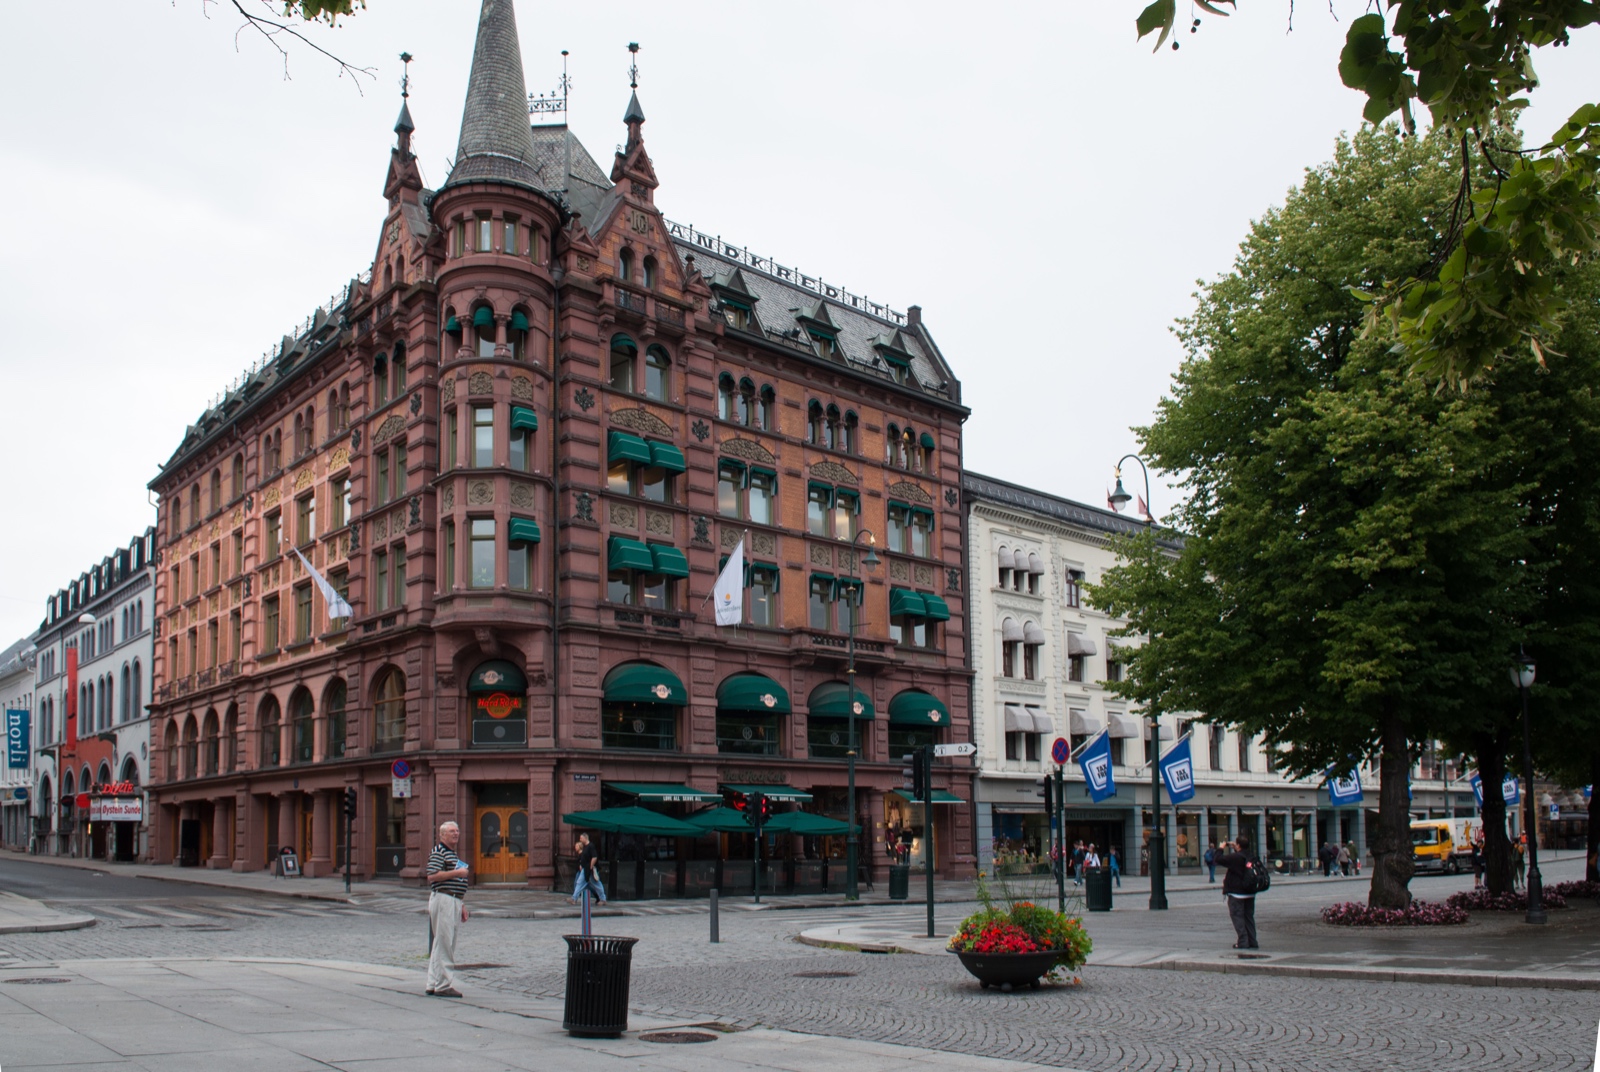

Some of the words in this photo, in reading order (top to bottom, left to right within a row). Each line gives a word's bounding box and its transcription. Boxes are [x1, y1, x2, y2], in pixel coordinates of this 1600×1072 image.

[670, 223, 907, 324] ANDKREDITT
[478, 698, 499, 707] Hard
[500, 698, 519, 709] Rock
[9, 714, 28, 763] norli
[1096, 764, 1107, 772] TAX
[1176, 773, 1189, 782] FREE
[102, 805, 123, 815] Øystein
[124, 804, 141, 814] Sunde
